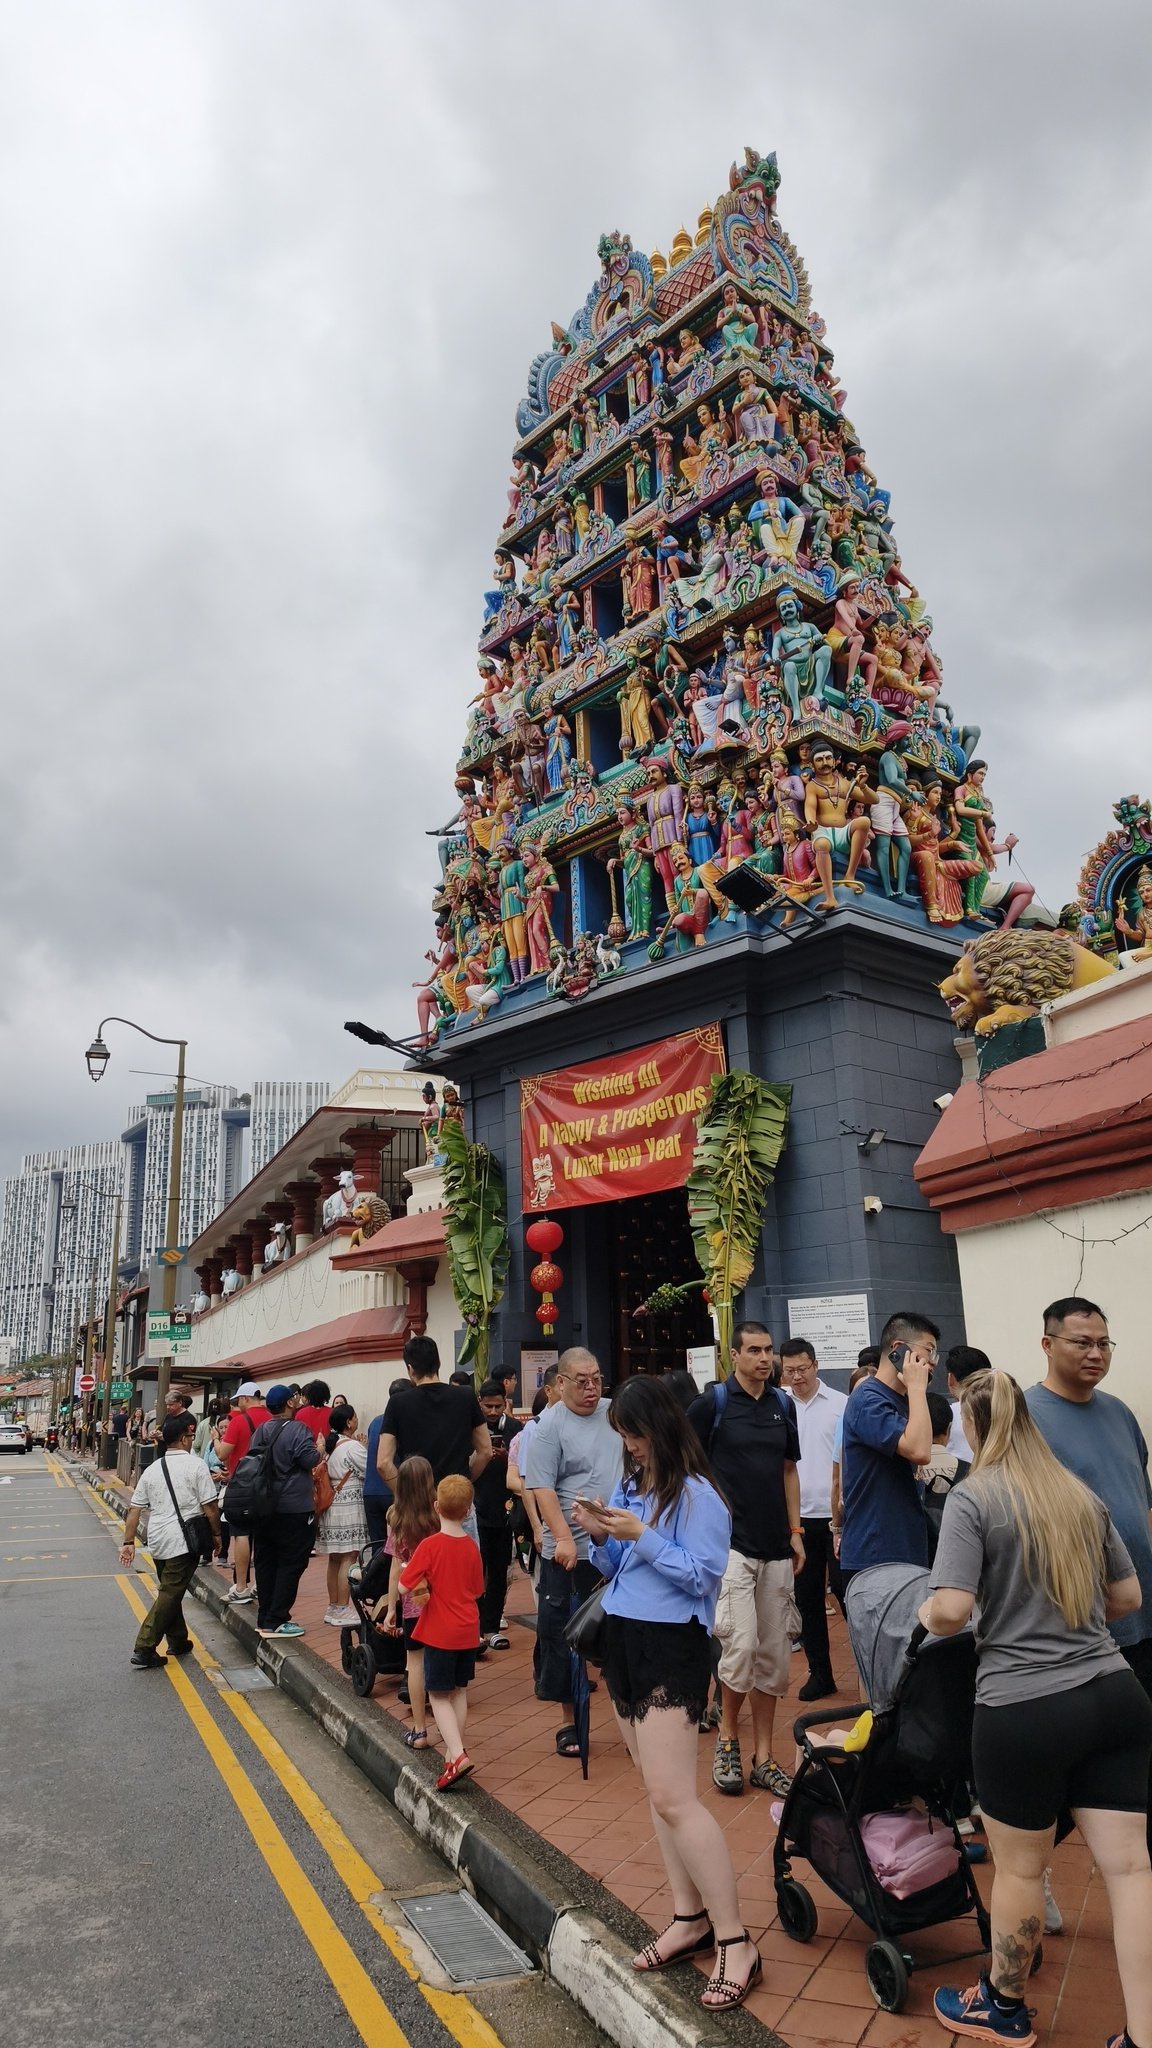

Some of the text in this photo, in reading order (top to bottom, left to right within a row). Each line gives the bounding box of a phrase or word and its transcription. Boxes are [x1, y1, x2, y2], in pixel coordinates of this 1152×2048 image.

[573, 1060, 661, 1104] Wishing All
[539, 1086, 707, 1147] A Happy & Prosperous
[564, 1133, 681, 1180] Lunar New Year
[151, 1322, 168, 1330] D16
[171, 1343, 178, 1353] 4
